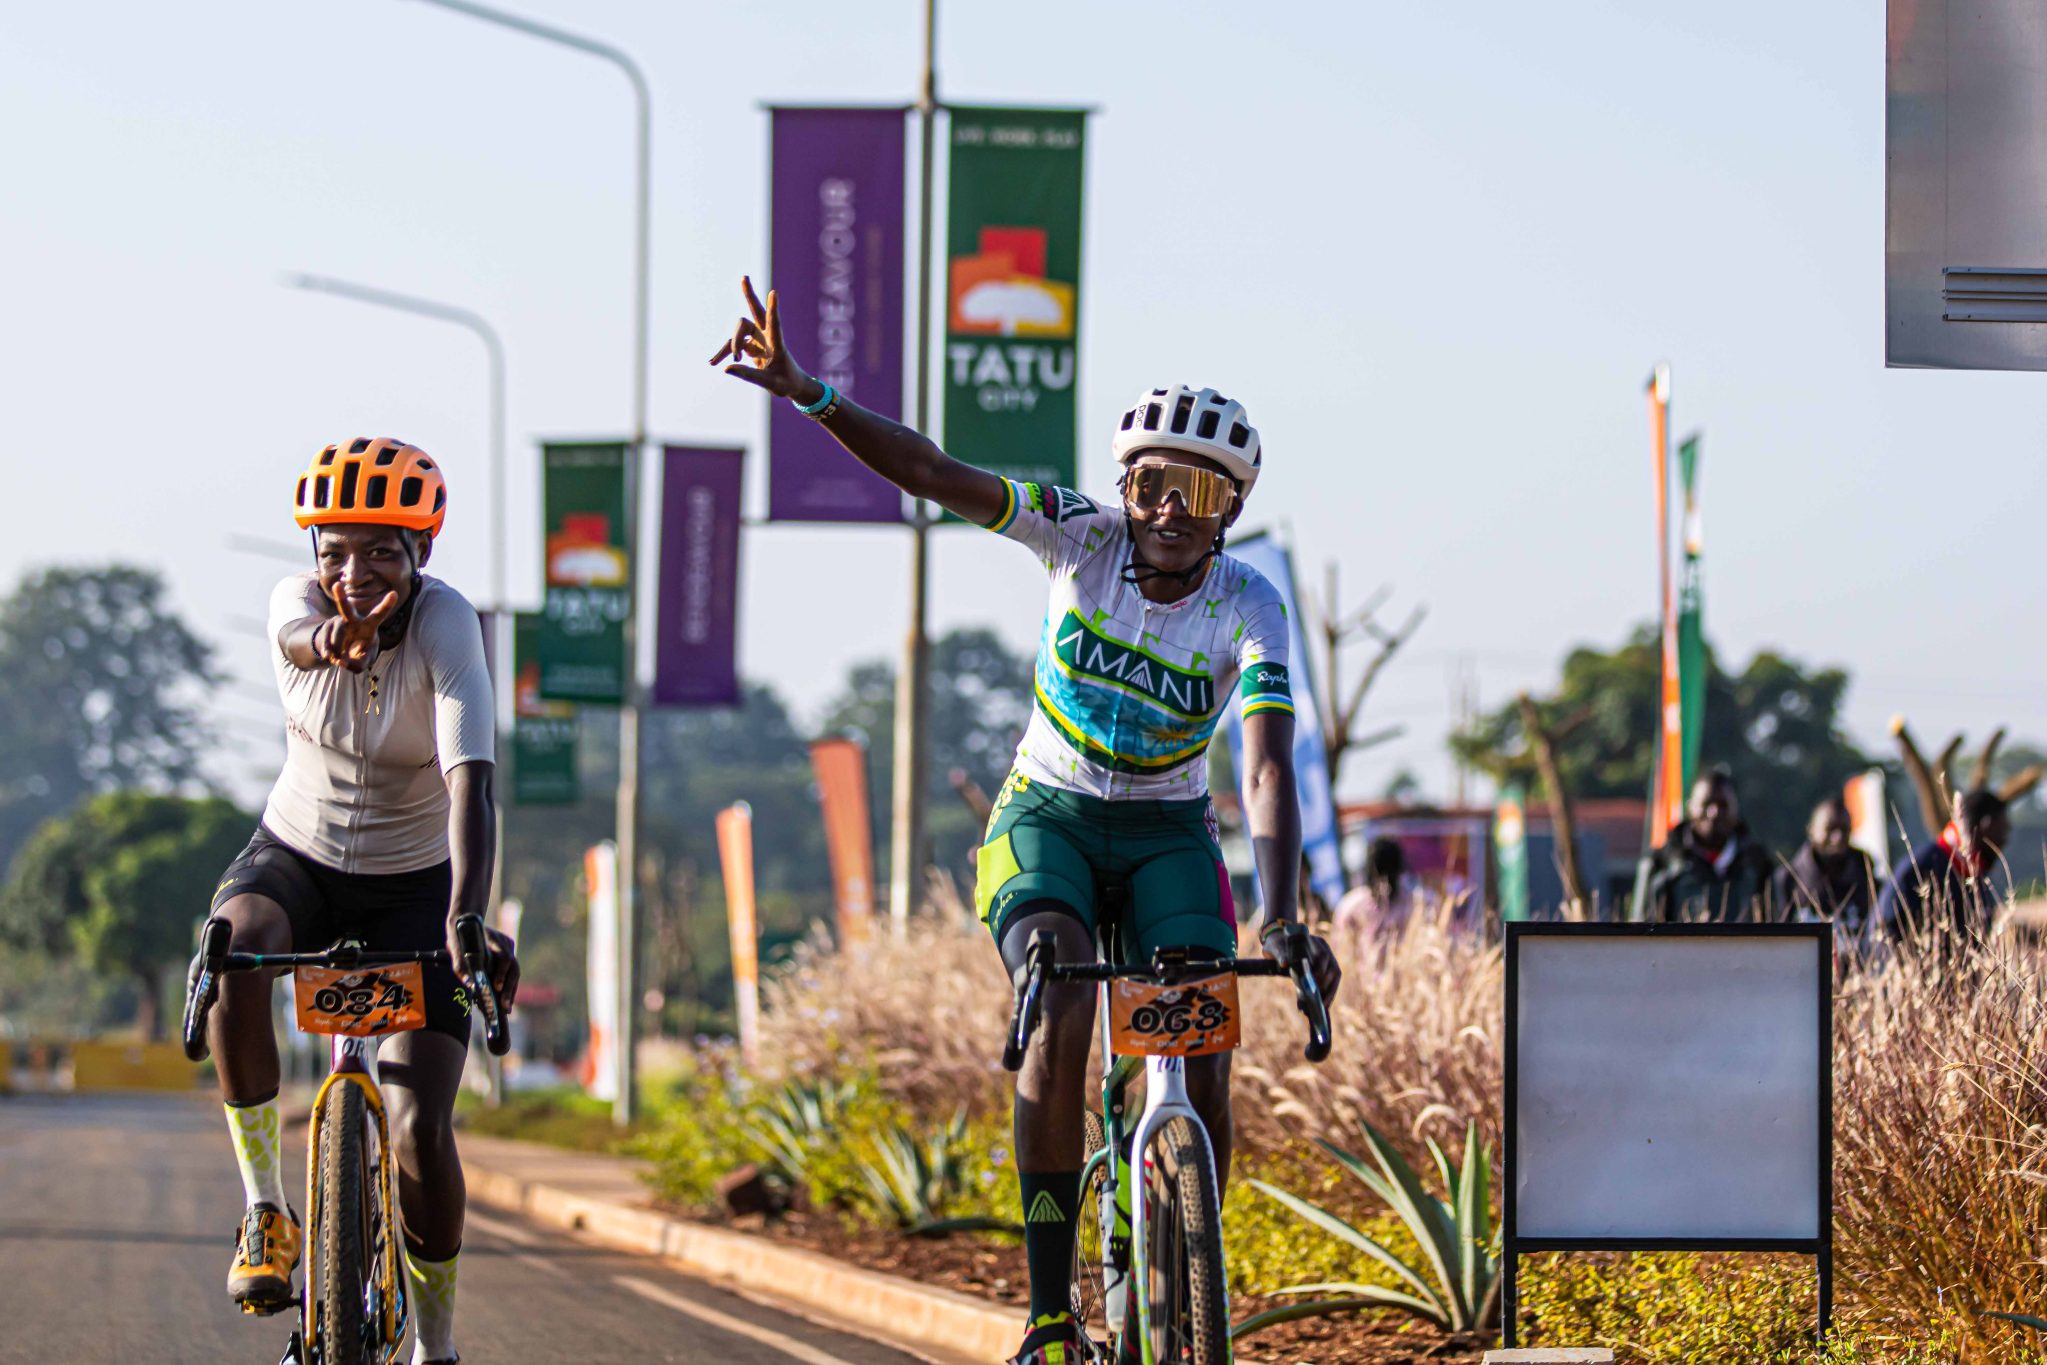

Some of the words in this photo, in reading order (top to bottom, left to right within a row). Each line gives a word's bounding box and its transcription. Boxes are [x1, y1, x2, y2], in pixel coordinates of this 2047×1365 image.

[949, 343, 1074, 390] TATU
[978, 390, 1039, 411] CITY
[1058, 629, 1208, 713] AMANI
[314, 982, 407, 1016] 084
[1131, 999, 1225, 1035] 068
